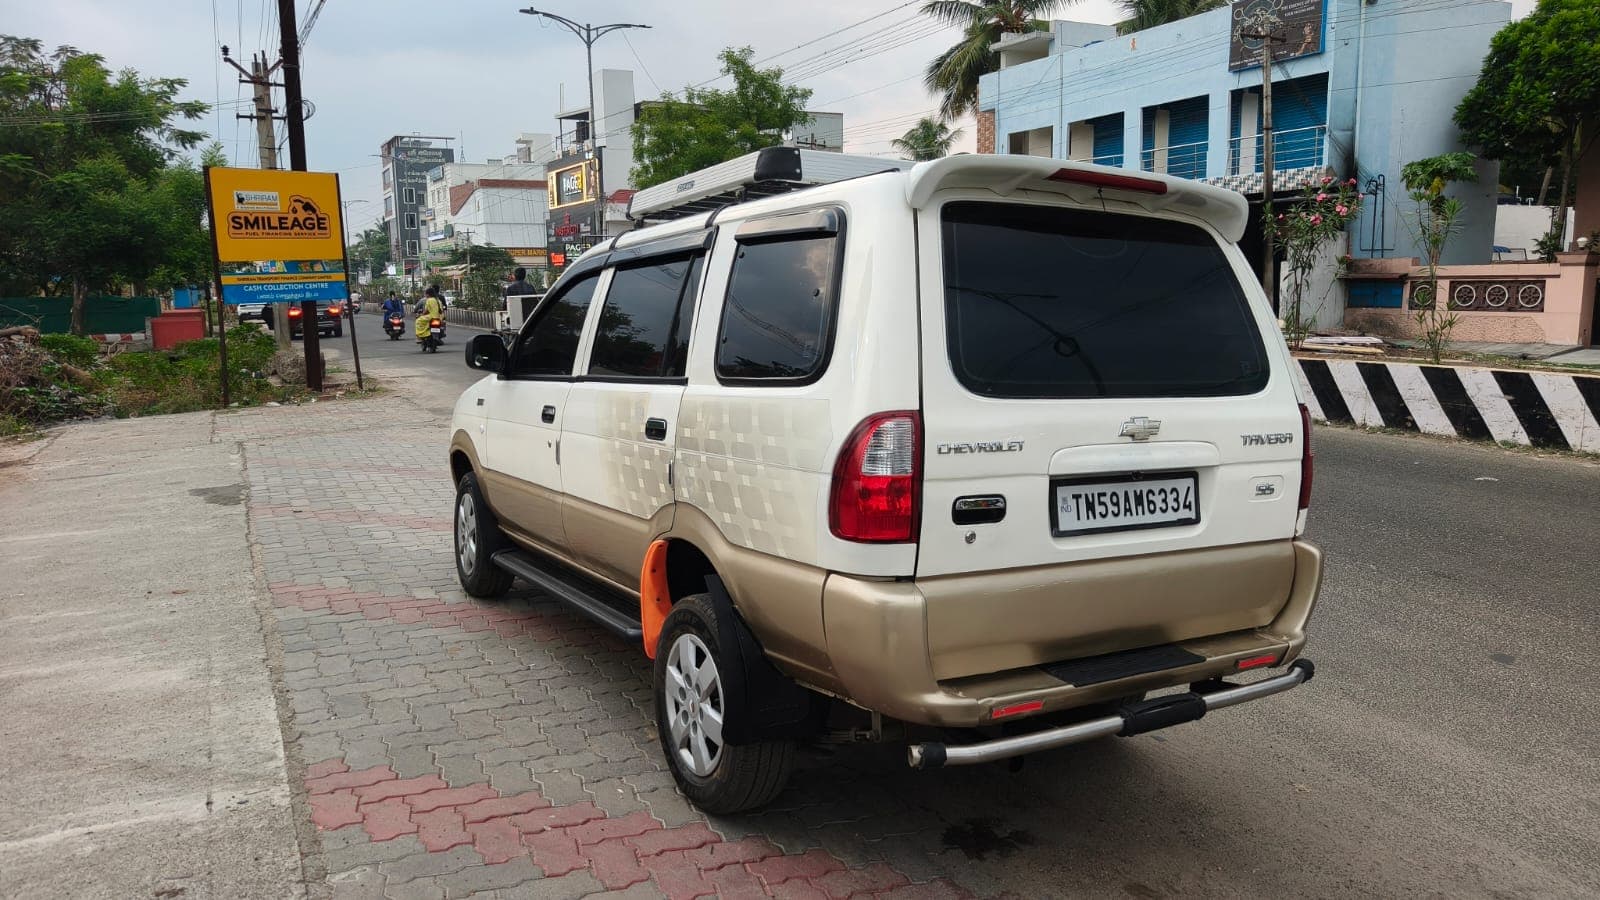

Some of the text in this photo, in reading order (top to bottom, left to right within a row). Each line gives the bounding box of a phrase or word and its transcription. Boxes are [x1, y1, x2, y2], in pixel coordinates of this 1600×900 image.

[231, 215, 328, 231] SMILEAGE
[1239, 432, 1294, 447] TAVERA
[936, 440, 1025, 455] CHEVROLET
[1071, 486, 1193, 522] TN59AM6334
